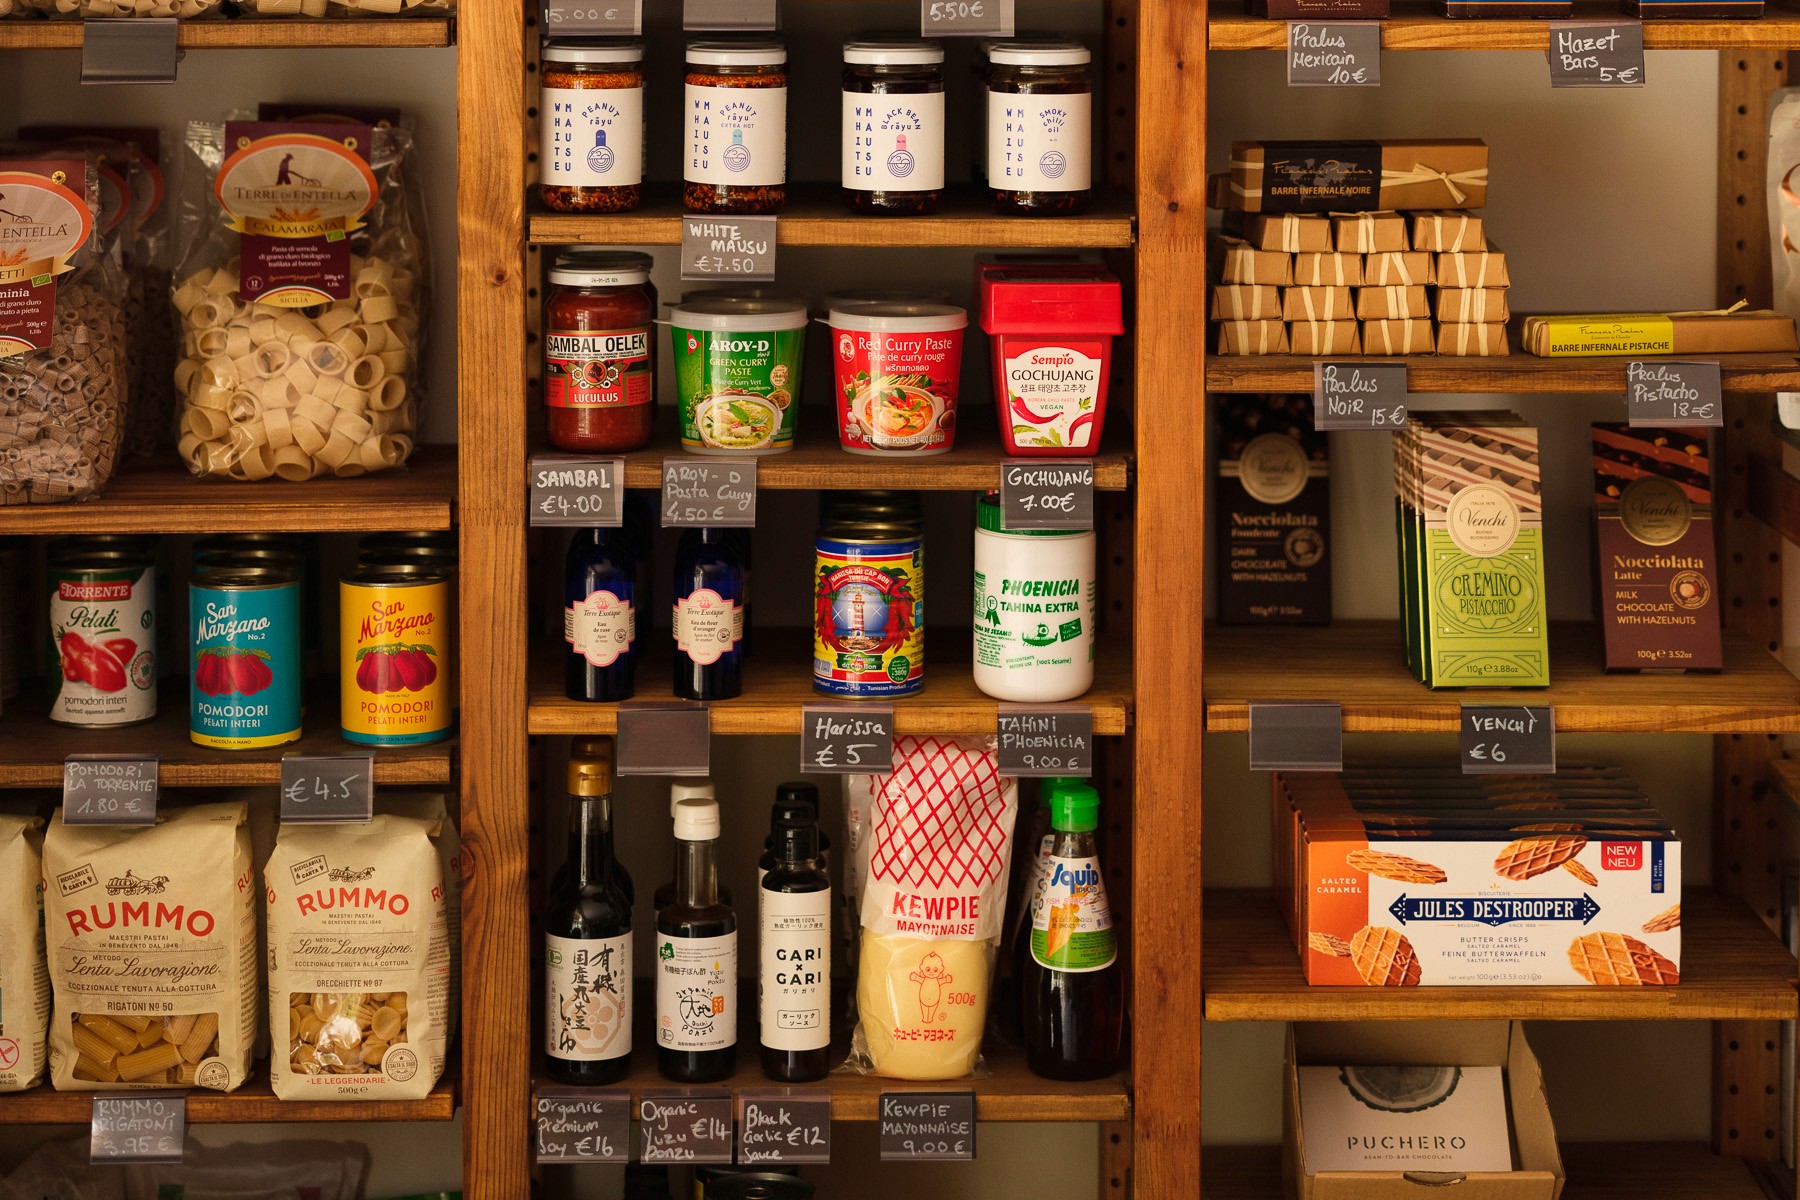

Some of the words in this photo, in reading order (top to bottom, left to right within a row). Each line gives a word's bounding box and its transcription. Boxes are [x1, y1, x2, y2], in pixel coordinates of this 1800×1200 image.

[1292, 24, 1346, 48] Pralus
[1558, 28, 1621, 54] Mazet
[1560, 54, 1599, 70] Bars
[1039, 108, 1067, 118] SMOKY
[1271, 186, 1299, 195] BARRE
[1301, 186, 1345, 195] INFERNALE
[1347, 186, 1371, 195] NOIRE
[689, 223, 741, 241] WHITE
[710, 239, 768, 255] MAUSU
[547, 335, 601, 352] SAMBAL
[605, 334, 645, 351] OELEK
[709, 339, 769, 352] AROY-D
[858, 338, 881, 350] Red
[885, 338, 922, 354] Curry
[925, 338, 952, 350] Paste
[1551, 344, 1579, 353] BARRE
[1581, 342, 1627, 352] INFERNALE
[1629, 340, 1670, 351] PISTACHE
[709, 358, 737, 367] GREEN
[739, 357, 768, 366] CURRY
[1031, 353, 1074, 367] Sempio
[725, 367, 752, 376] PASTE
[1011, 369, 1094, 382] GOCHUJANG
[1062, 384, 1086, 393] 고추장
[574, 392, 618, 403] LUCULLUS
[536, 469, 611, 488] SAMBAL
[1007, 468, 1092, 487] GOCHUJANG
[666, 502, 707, 523] 4.50
[713, 507, 724, 521] €
[1459, 507, 1508, 529] Venchi
[1614, 554, 1704, 569] Nocciolata
[1614, 571, 1642, 580] Latte
[64, 584, 128, 598] TORRENTE
[1001, 579, 1080, 597] PHOENICIA
[1451, 572, 1522, 597] CREMINO
[1616, 591, 1638, 599] MILK
[207, 601, 237, 624] San
[372, 600, 405, 623] San
[1000, 602, 1042, 613] TAHINA
[1045, 601, 1079, 613] EXTRA
[1460, 597, 1516, 615] PISTACCHIO
[1616, 603, 1674, 612] CHOCOLATE
[66, 606, 119, 628] Pelati
[1617, 616, 1641, 624] WITH
[1642, 616, 1696, 624] HAZELNUTS
[197, 617, 271, 645] Marzano
[358, 614, 435, 643] Marzano
[198, 703, 269, 718] POMODORI
[361, 700, 434, 714] POMODORI
[368, 715, 395, 725] PELATI
[398, 714, 427, 724] INTERI
[816, 718, 886, 739] Harissa
[1023, 755, 1061, 770] 9.00
[1068, 757, 1079, 769] €
[67, 777, 87, 791] LA
[93, 777, 155, 792] TORRENTE
[77, 798, 118, 813] 1.80
[124, 798, 141, 812] €
[1606, 845, 1637, 856] NEW
[1608, 857, 1636, 867] NEU
[297, 887, 410, 917] RUMMO
[892, 891, 979, 921] KEWPIE
[1413, 901, 1465, 918] JULES
[1473, 901, 1575, 918] DESTROOPER
[66, 901, 215, 938] RUMMO
[897, 920, 976, 936] MAYONNAISE
[776, 948, 822, 961] GARI
[776, 971, 822, 985] GARI
[947, 992, 976, 1006] 500g
[903, 1140, 949, 1155] 9.00
[954, 1140, 965, 1154] €
[1348, 1136, 1466, 1150] PUCHERO
